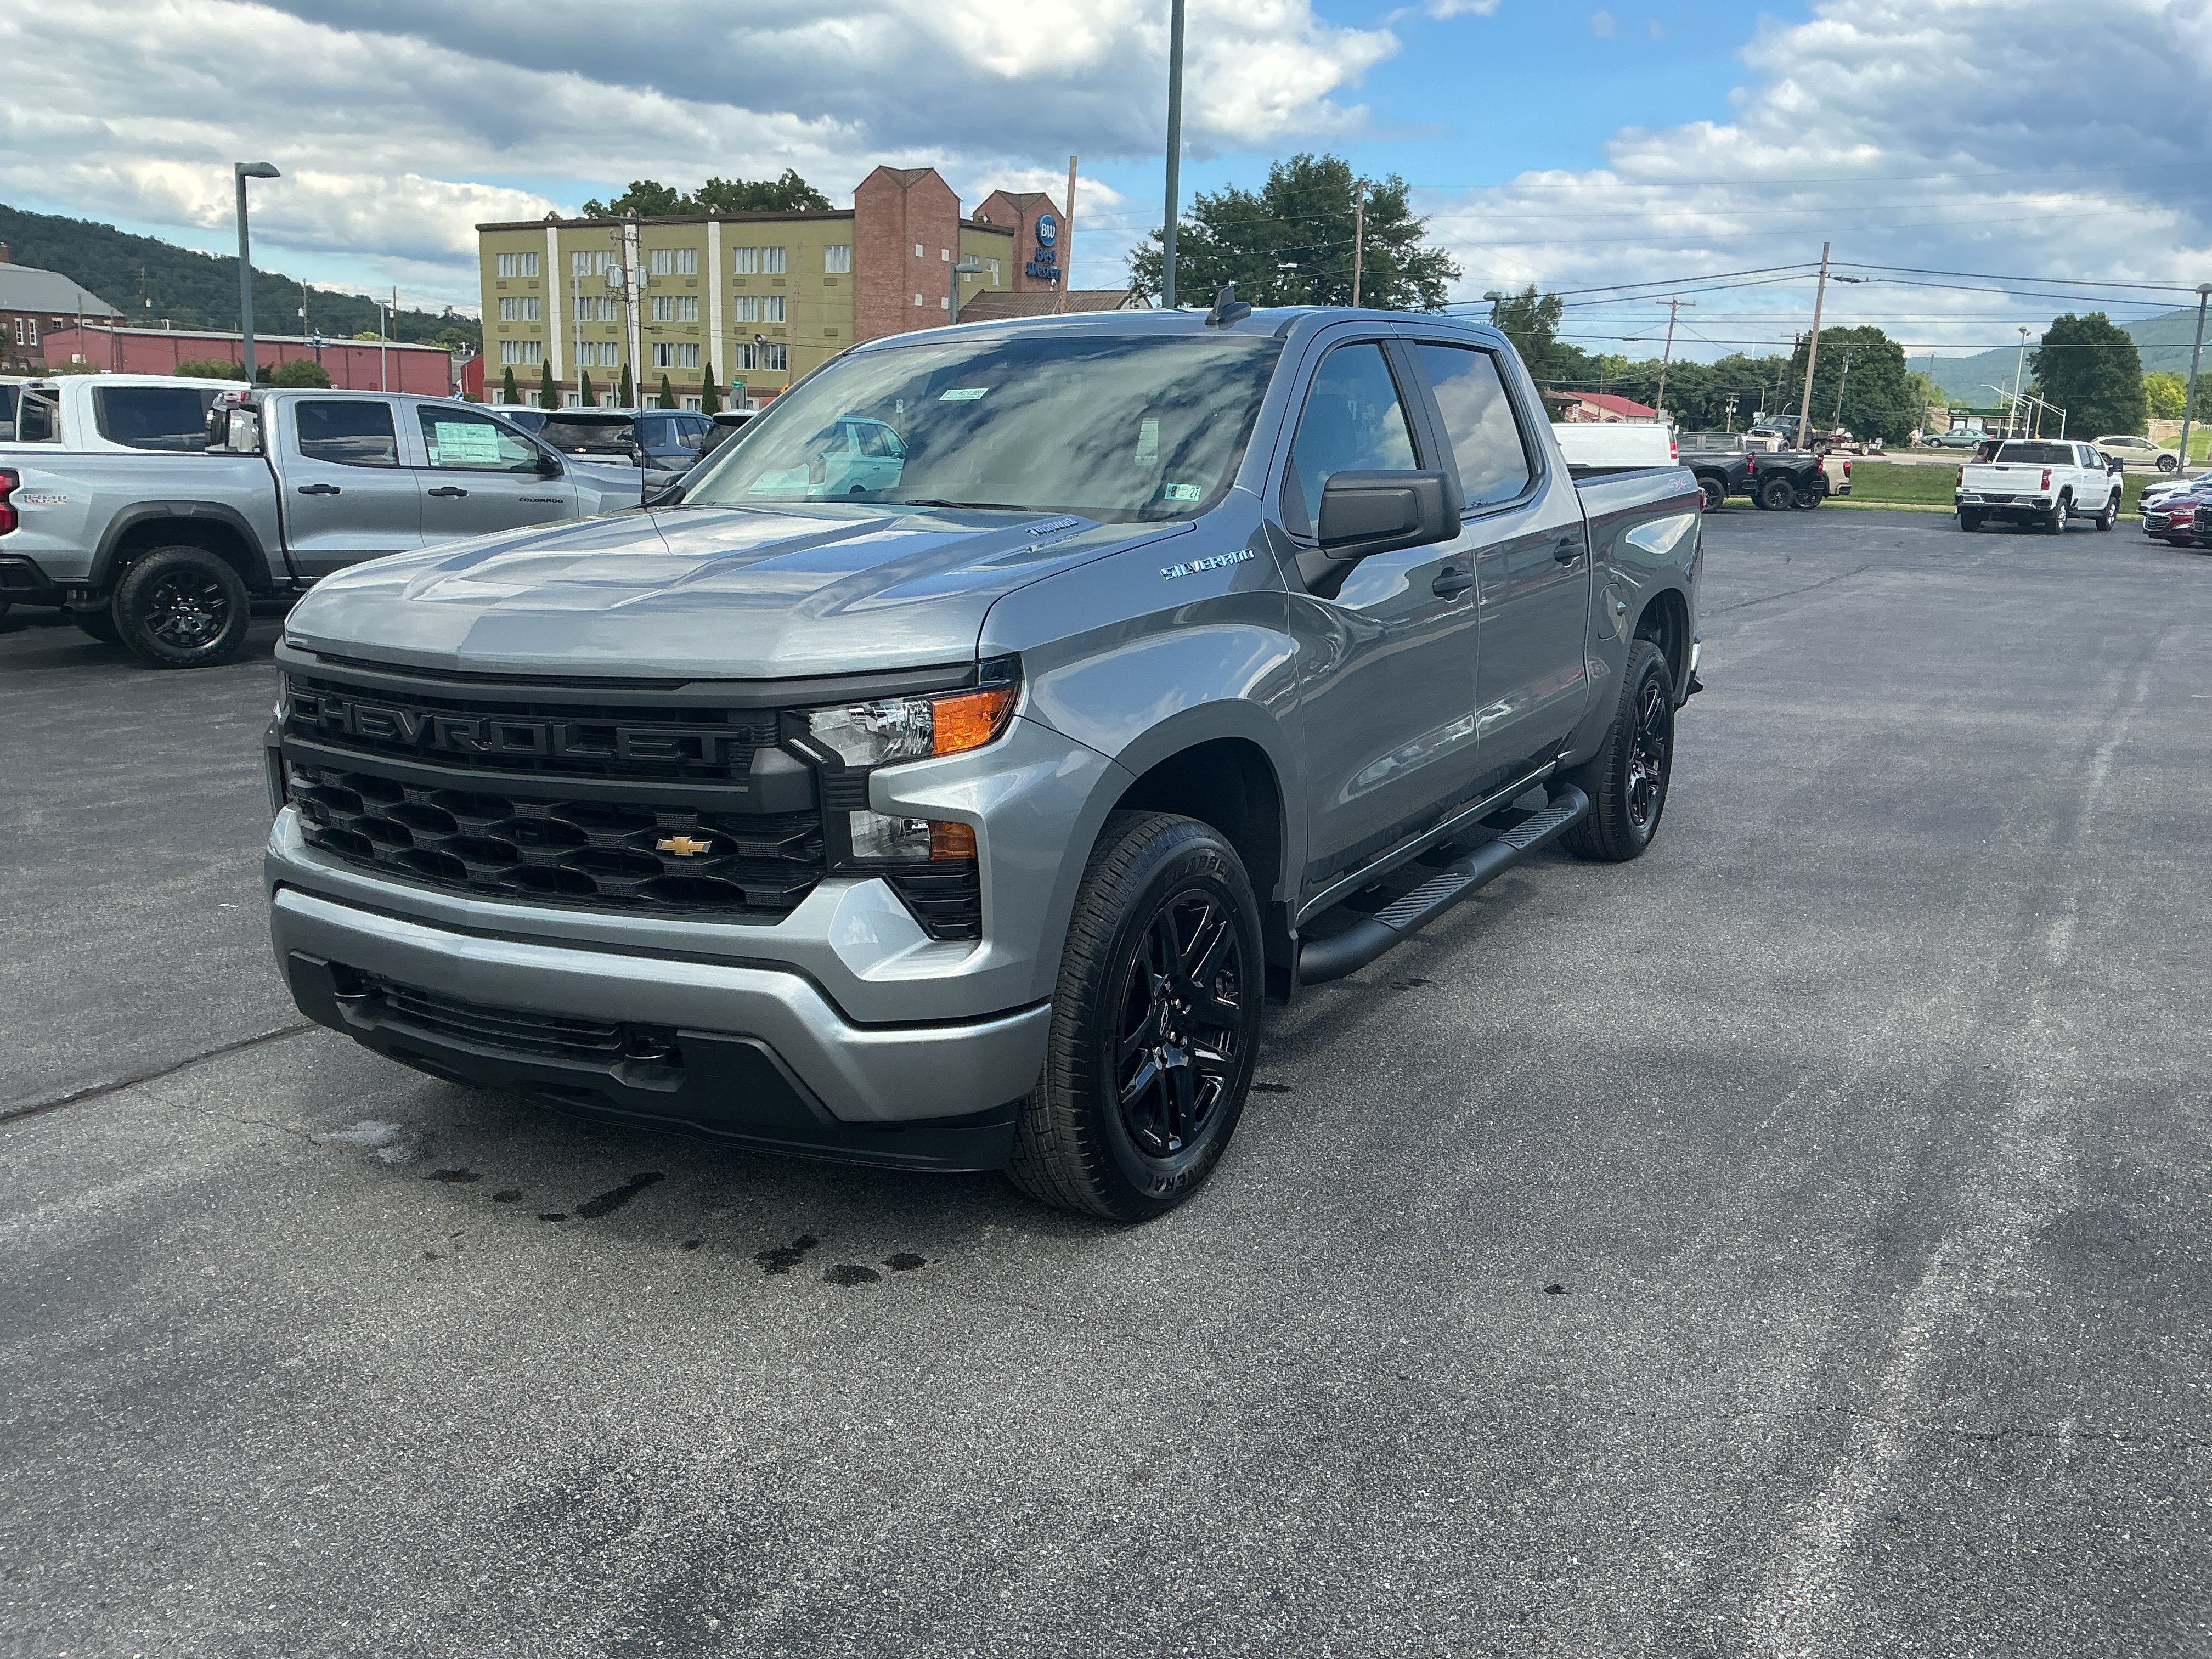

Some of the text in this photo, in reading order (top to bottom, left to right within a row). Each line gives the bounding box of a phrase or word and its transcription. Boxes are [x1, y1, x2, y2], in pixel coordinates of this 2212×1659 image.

[1041, 223, 1056, 238] BW
[1035, 247, 1056, 263] Best
[1026, 262, 1062, 280] Wester
[1159, 548, 1255, 581] SILVERADO
[289, 692, 754, 764] CHEVROLET
